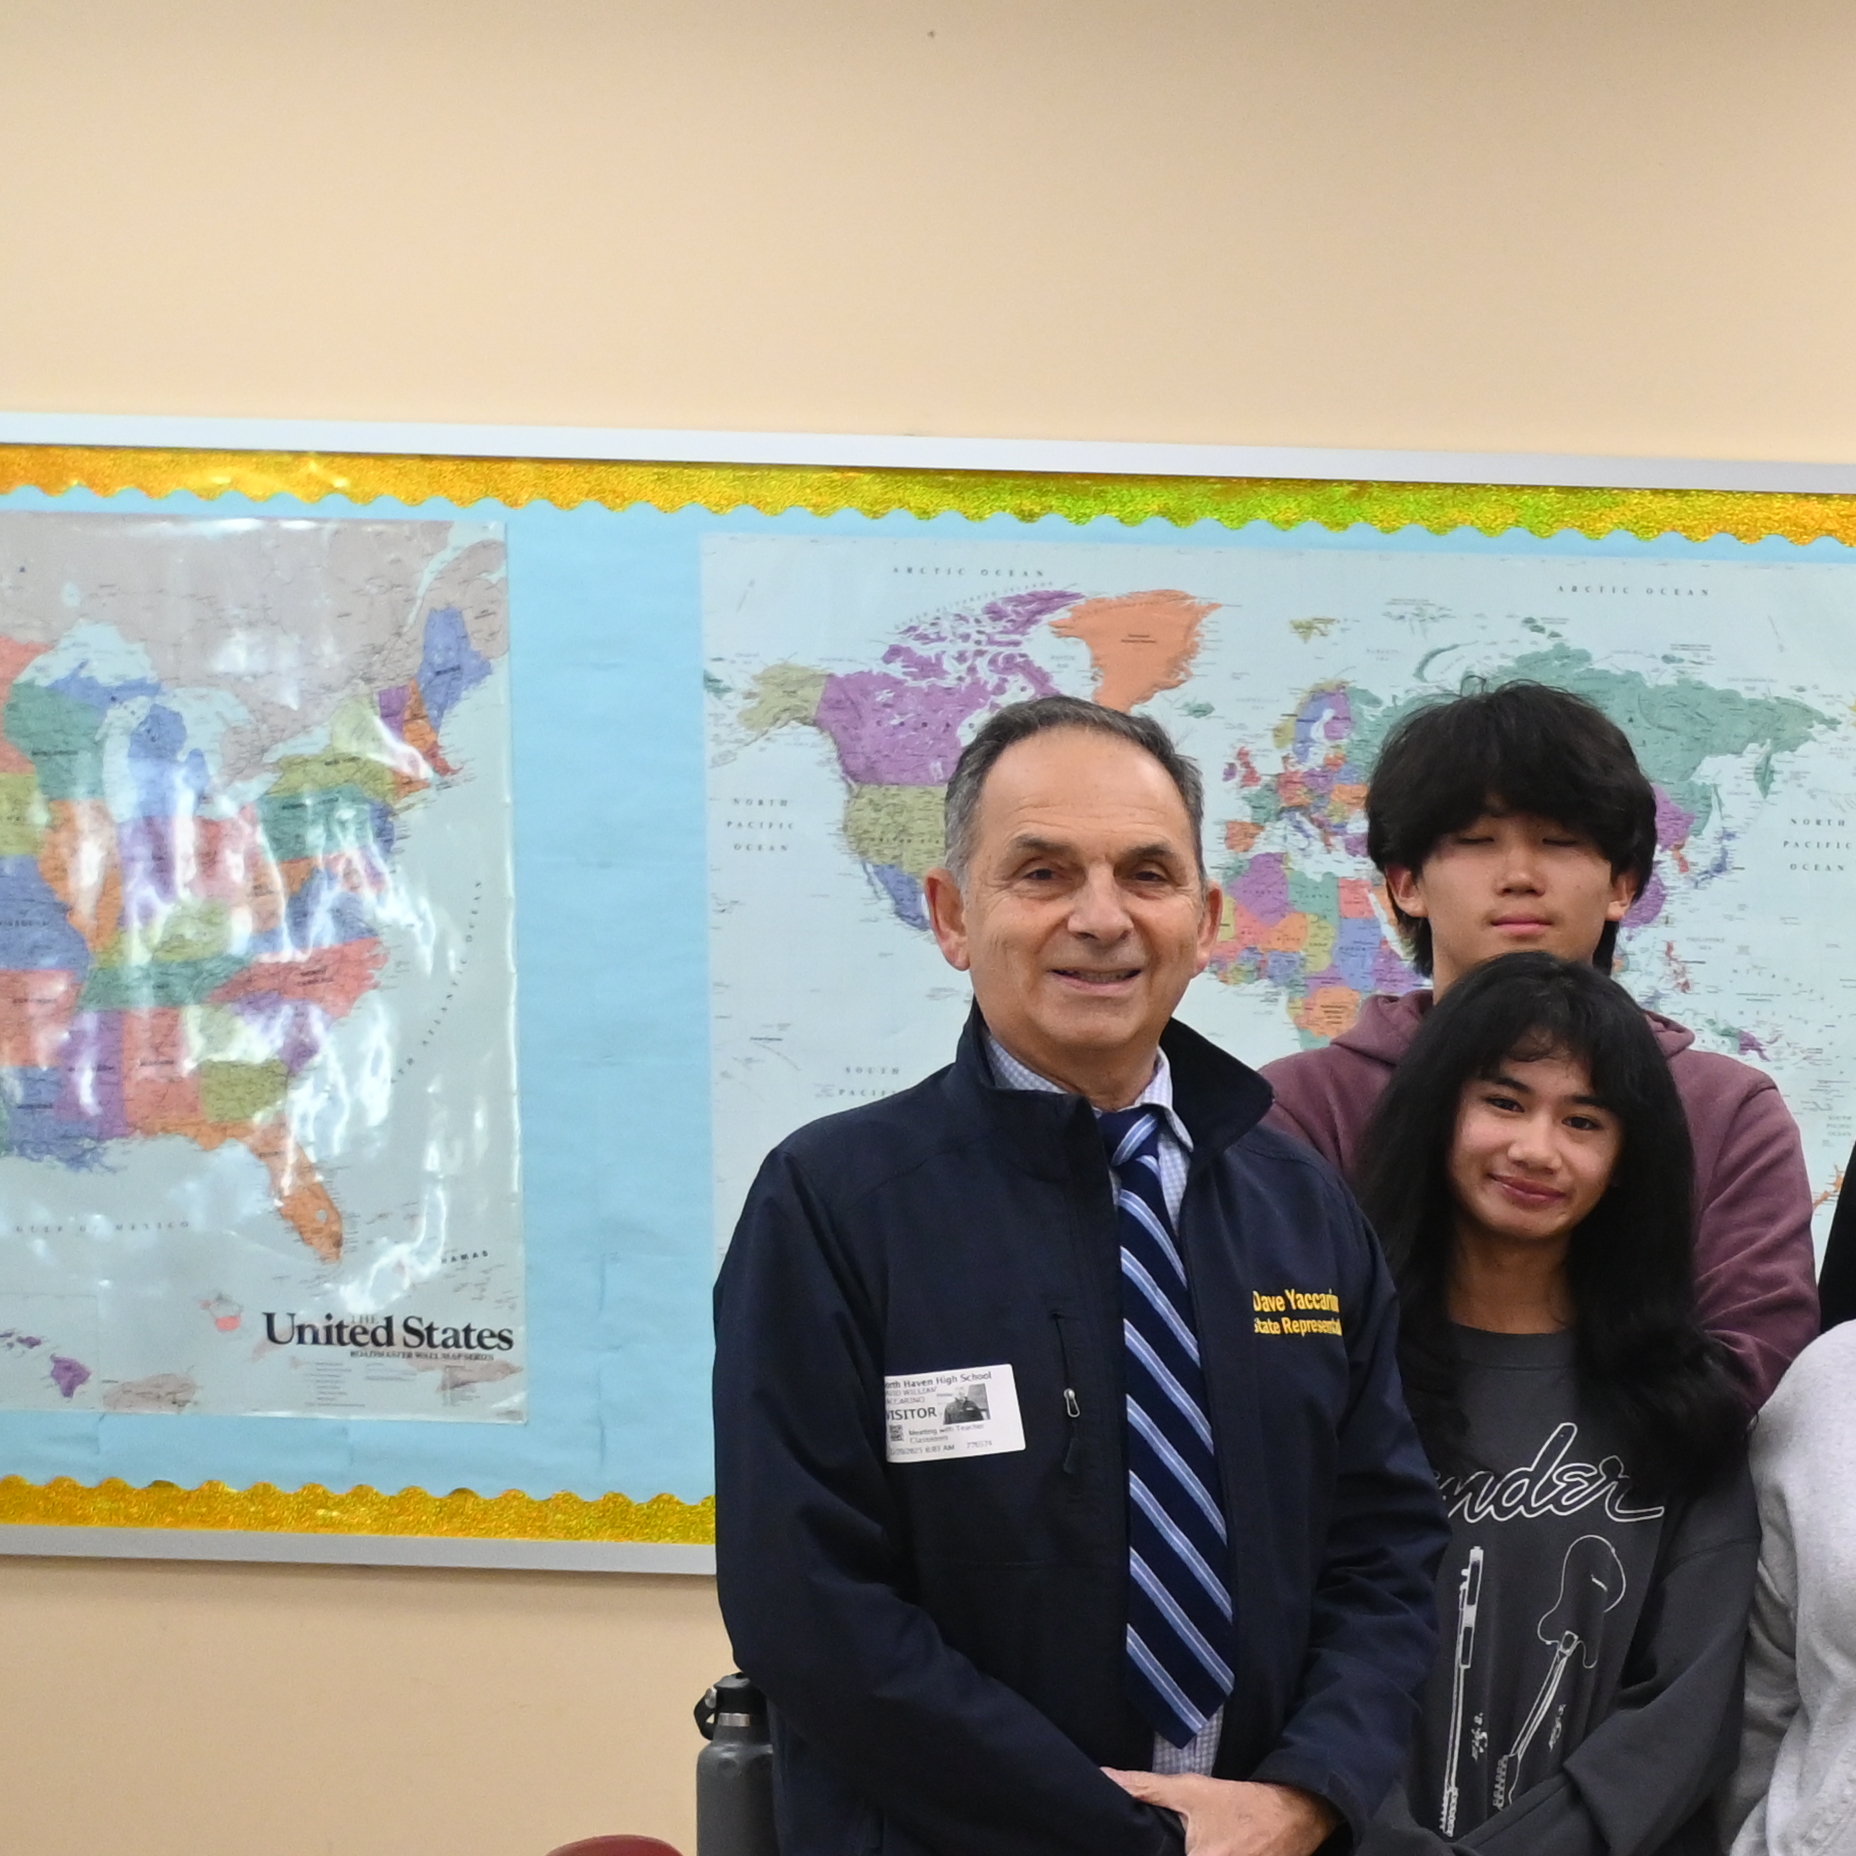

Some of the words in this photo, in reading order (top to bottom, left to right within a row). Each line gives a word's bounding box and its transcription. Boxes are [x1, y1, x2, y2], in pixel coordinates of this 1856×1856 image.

[1557, 585, 1630, 595] ARCTIC
[1645, 586, 1709, 597] OCEAN
[1791, 818, 1846, 827] NORTH
[1783, 840, 1852, 850] PACIFIC
[1789, 863, 1845, 872] OCEAN
[1253, 1290, 1286, 1313] Dave
[262, 1311, 396, 1348] United
[402, 1314, 515, 1351] States
[1254, 1317, 1281, 1335] State
[903, 1378, 933, 1388] Haven
[935, 1374, 958, 1385] High
[960, 1371, 992, 1381] School
